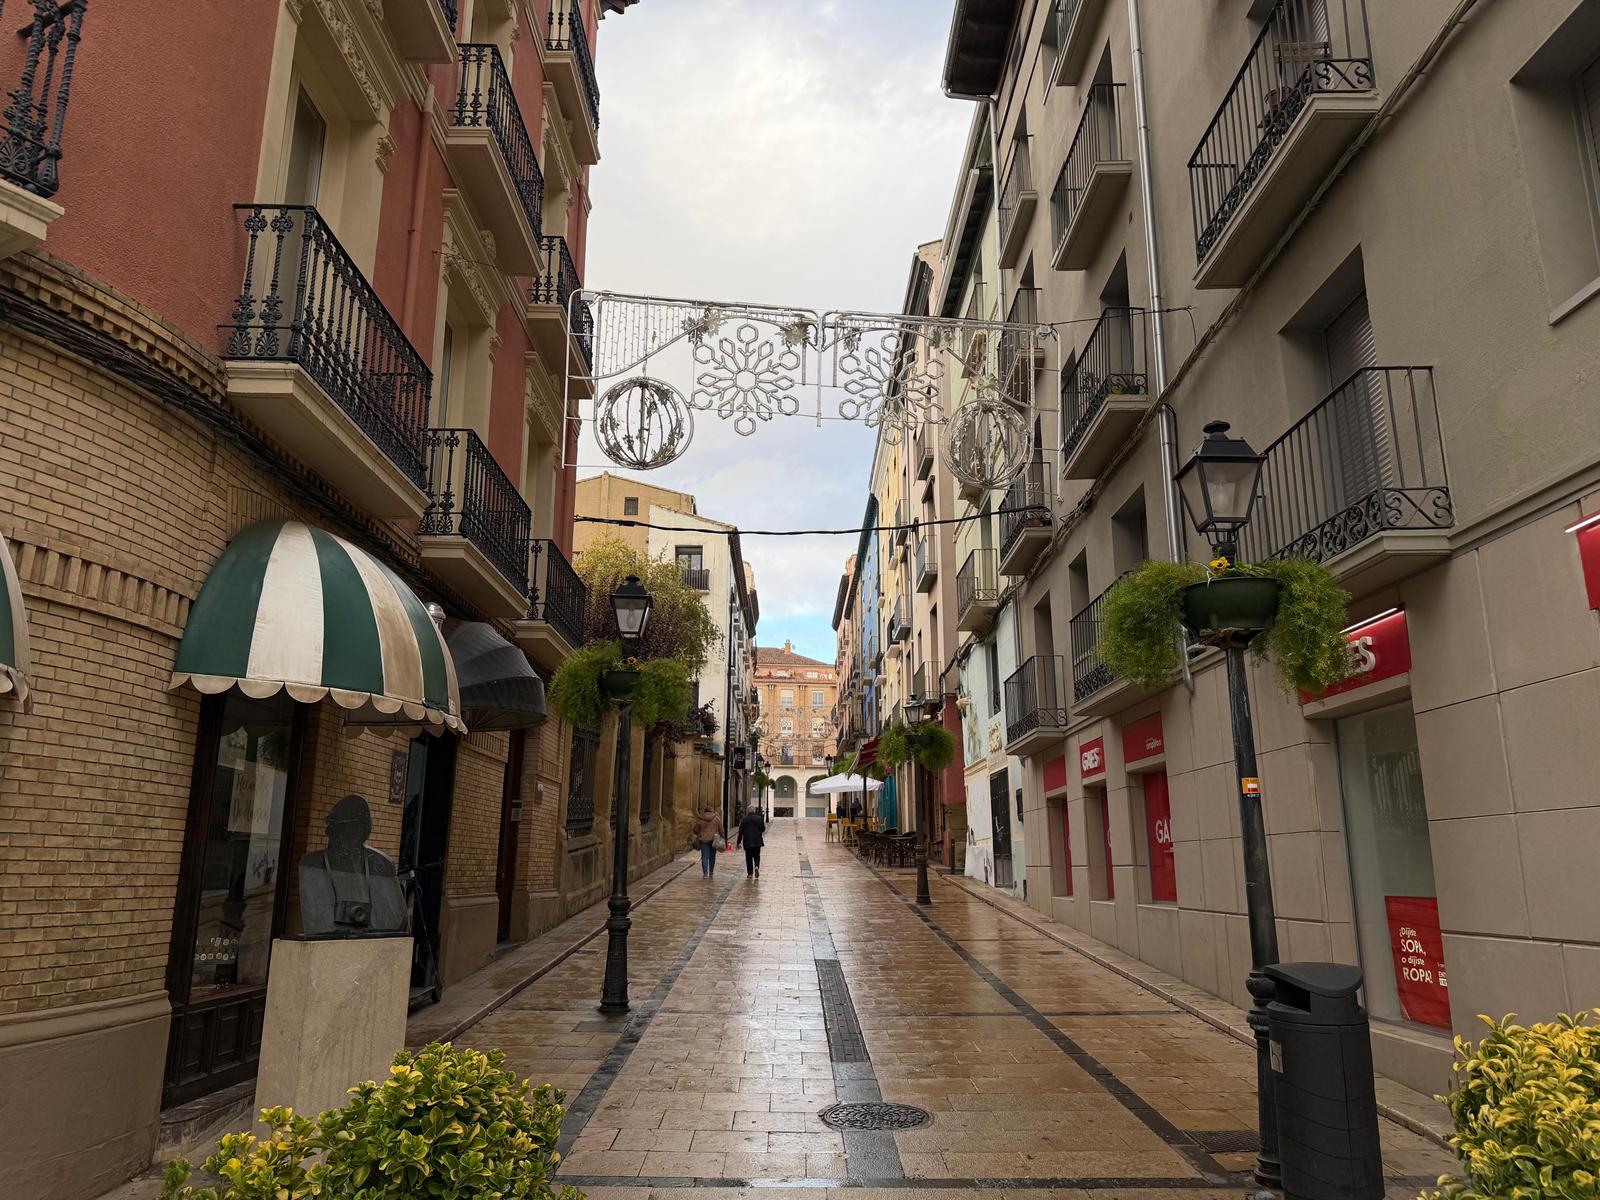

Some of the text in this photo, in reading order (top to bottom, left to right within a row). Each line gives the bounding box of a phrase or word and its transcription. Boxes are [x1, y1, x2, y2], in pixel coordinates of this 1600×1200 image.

[1082, 747, 1100, 771] GAES
[1155, 819, 1171, 844] GA
[1400, 939, 1426, 956] SOPA,
[1408, 956, 1425, 966] dijiste
[1402, 967, 1433, 983] ROPA?
